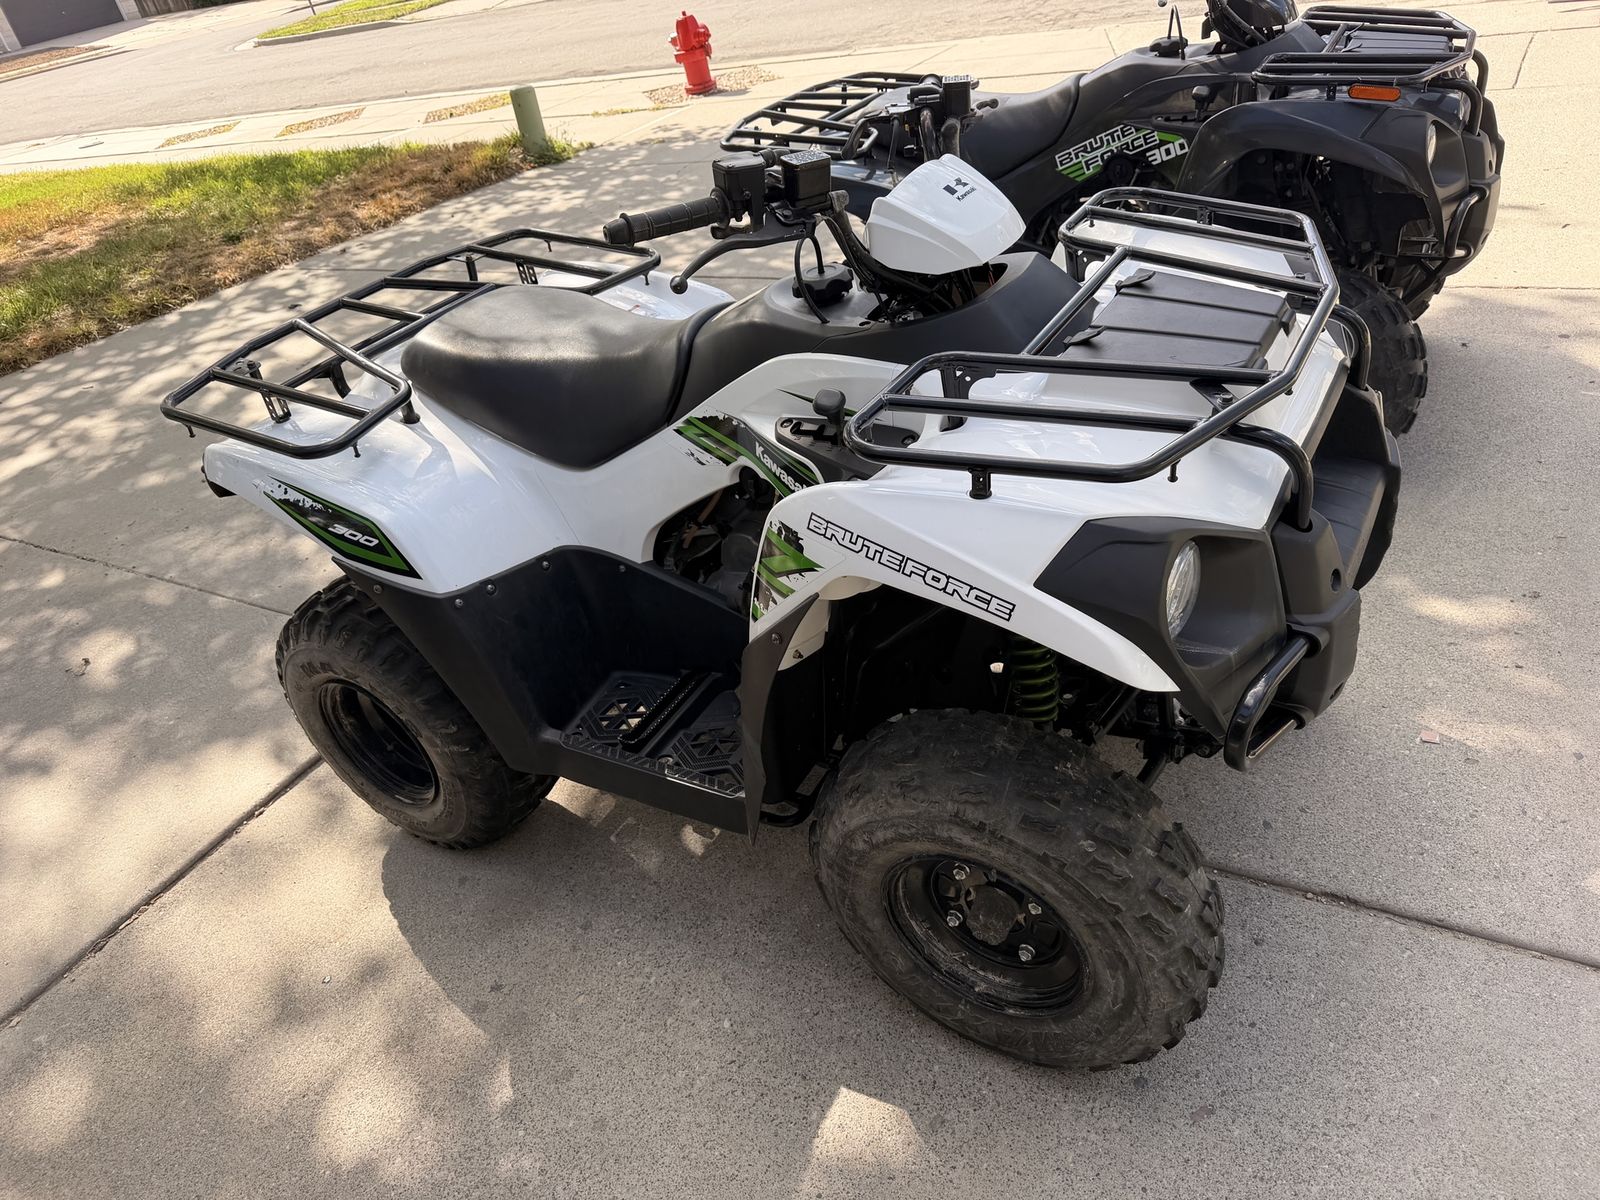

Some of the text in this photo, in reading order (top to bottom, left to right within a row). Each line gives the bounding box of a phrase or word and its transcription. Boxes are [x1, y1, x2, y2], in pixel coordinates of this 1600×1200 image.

[1055, 124, 1136, 170] BRUTE
[1146, 138, 1189, 165] 300
[755, 441, 807, 492] Kawasa
[327, 523, 380, 547] 300
[806, 512, 1017, 622] BRUTE FORCE
